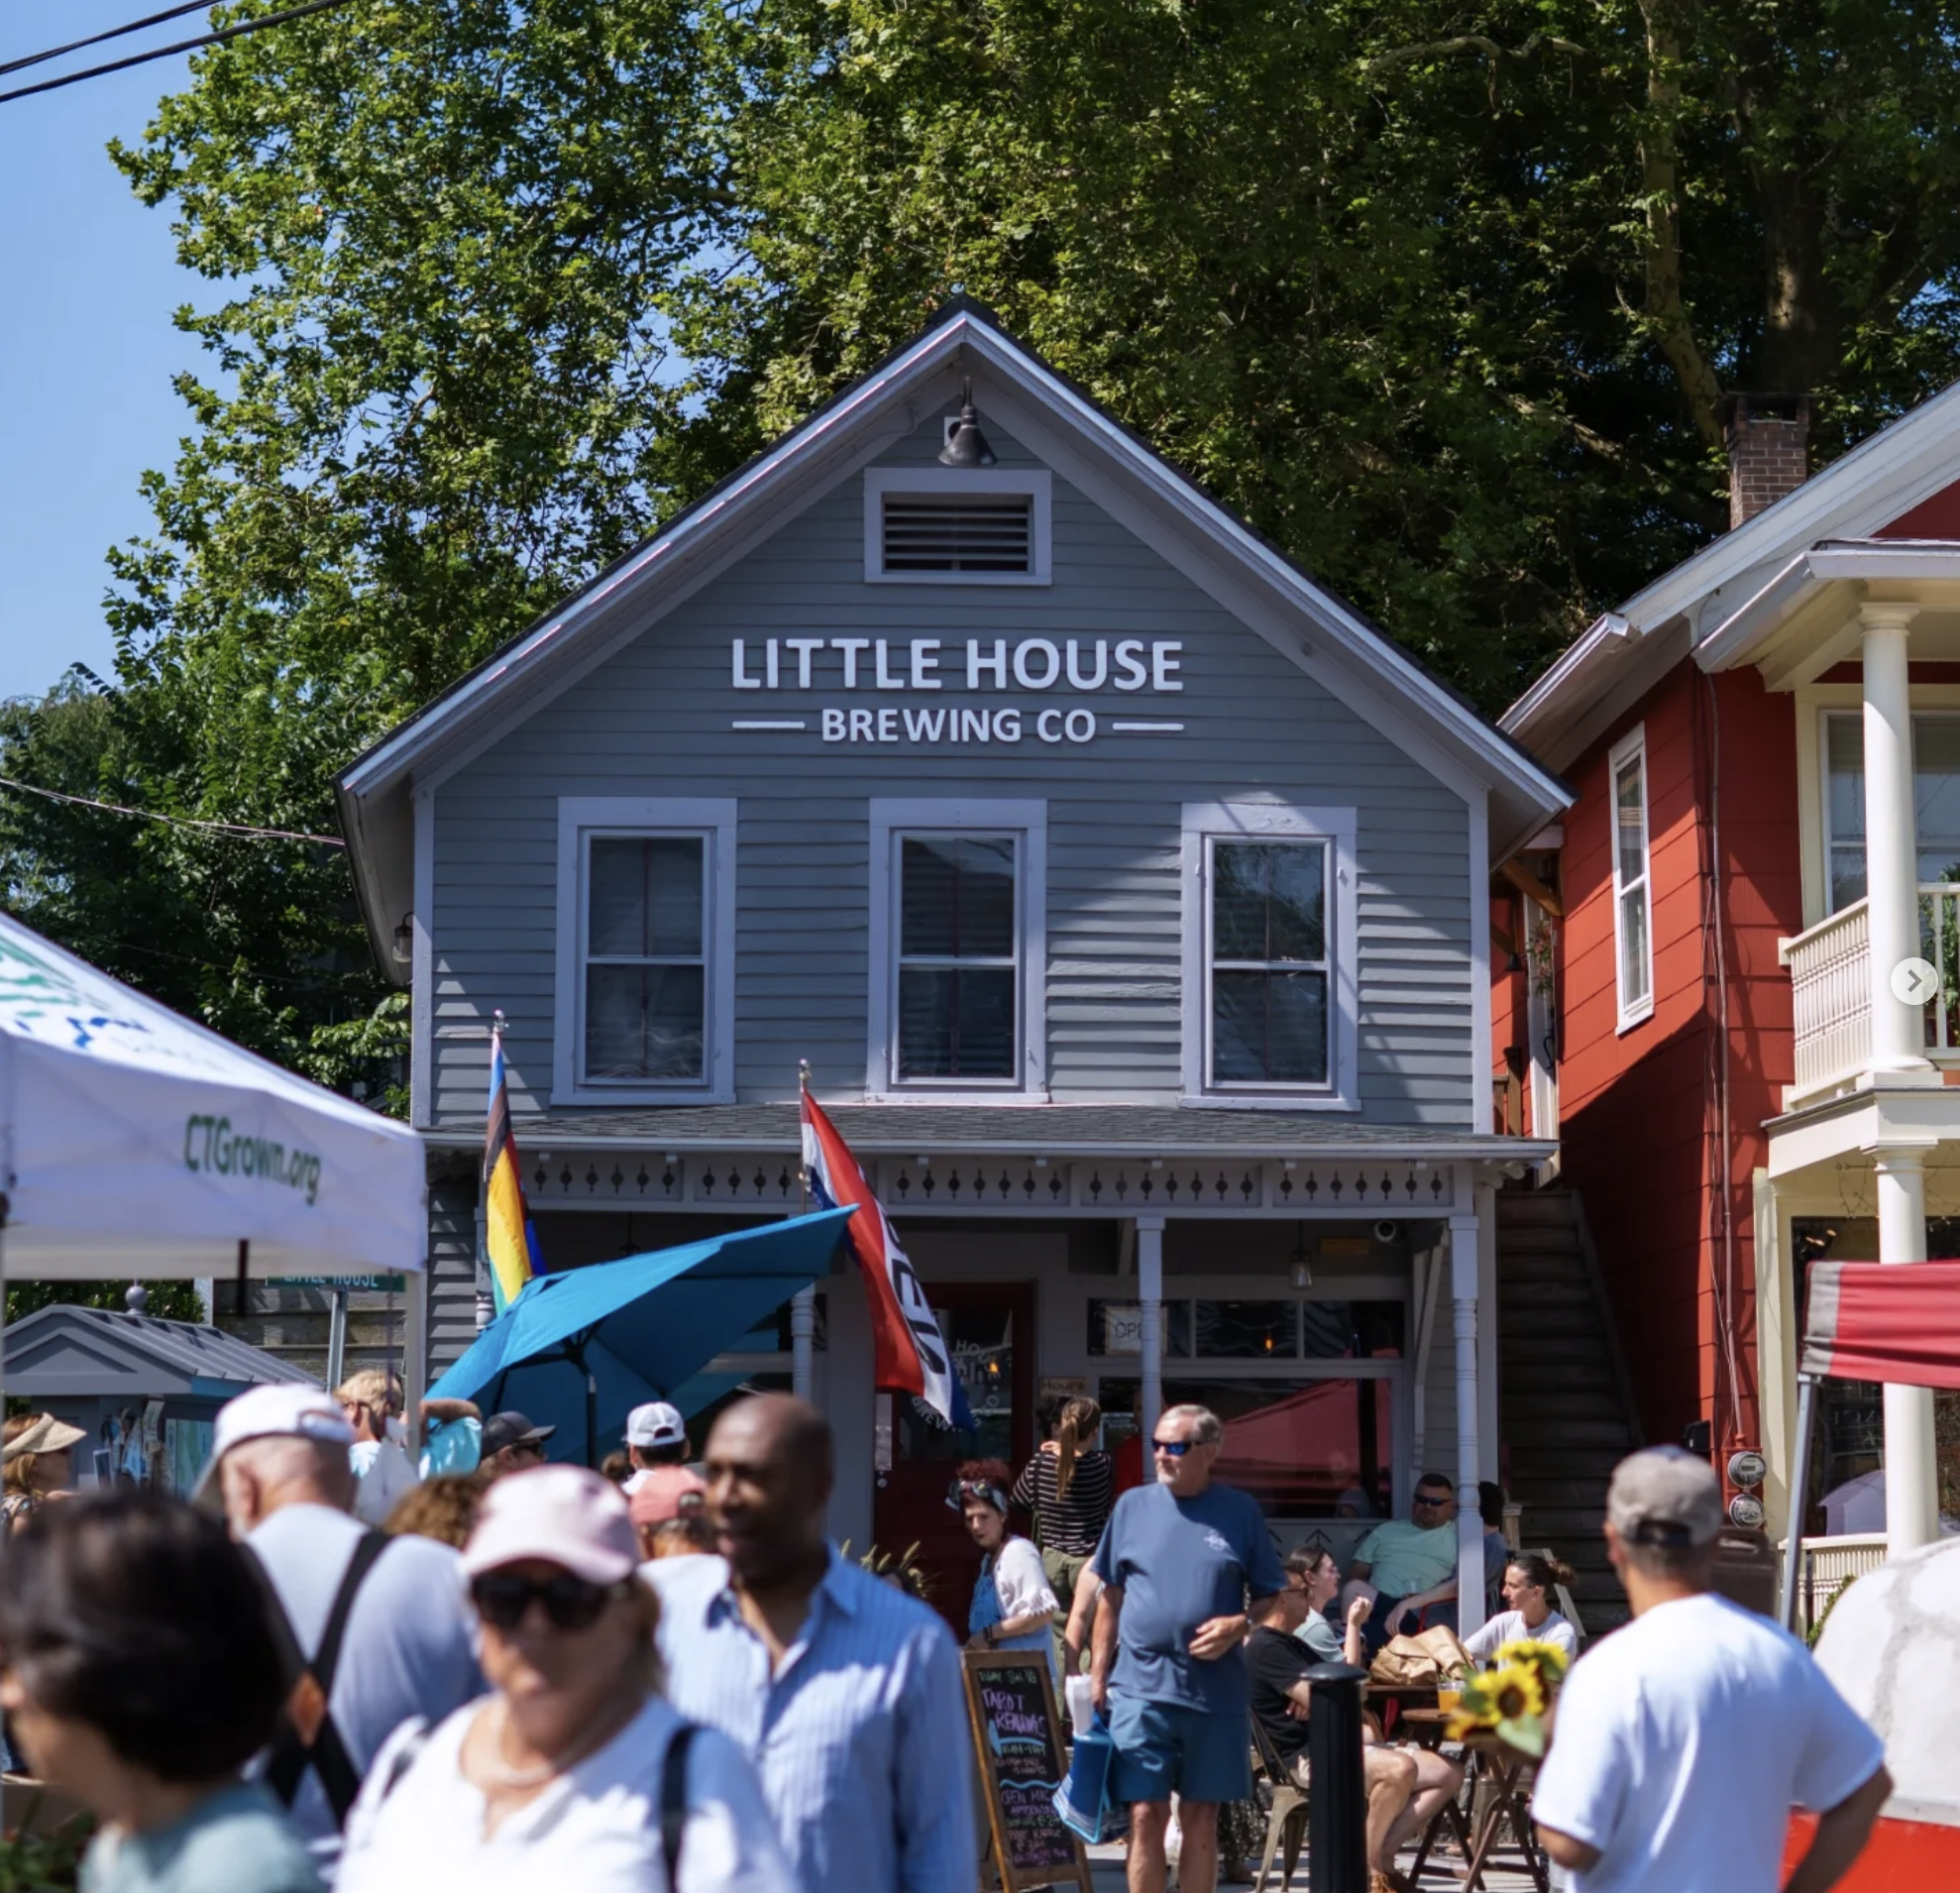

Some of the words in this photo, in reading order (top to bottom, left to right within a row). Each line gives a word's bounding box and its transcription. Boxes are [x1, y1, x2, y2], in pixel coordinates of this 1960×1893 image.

[732, 638, 942, 689] LITTLE
[966, 638, 1184, 692] HOUSE
[821, 709, 1022, 743] BREWING
[1037, 709, 1097, 743] CO
[183, 1113, 321, 1207] CTGrown.org
[1043, 1379, 1086, 1392] Hours
[982, 1688, 1024, 1713] TAROT
